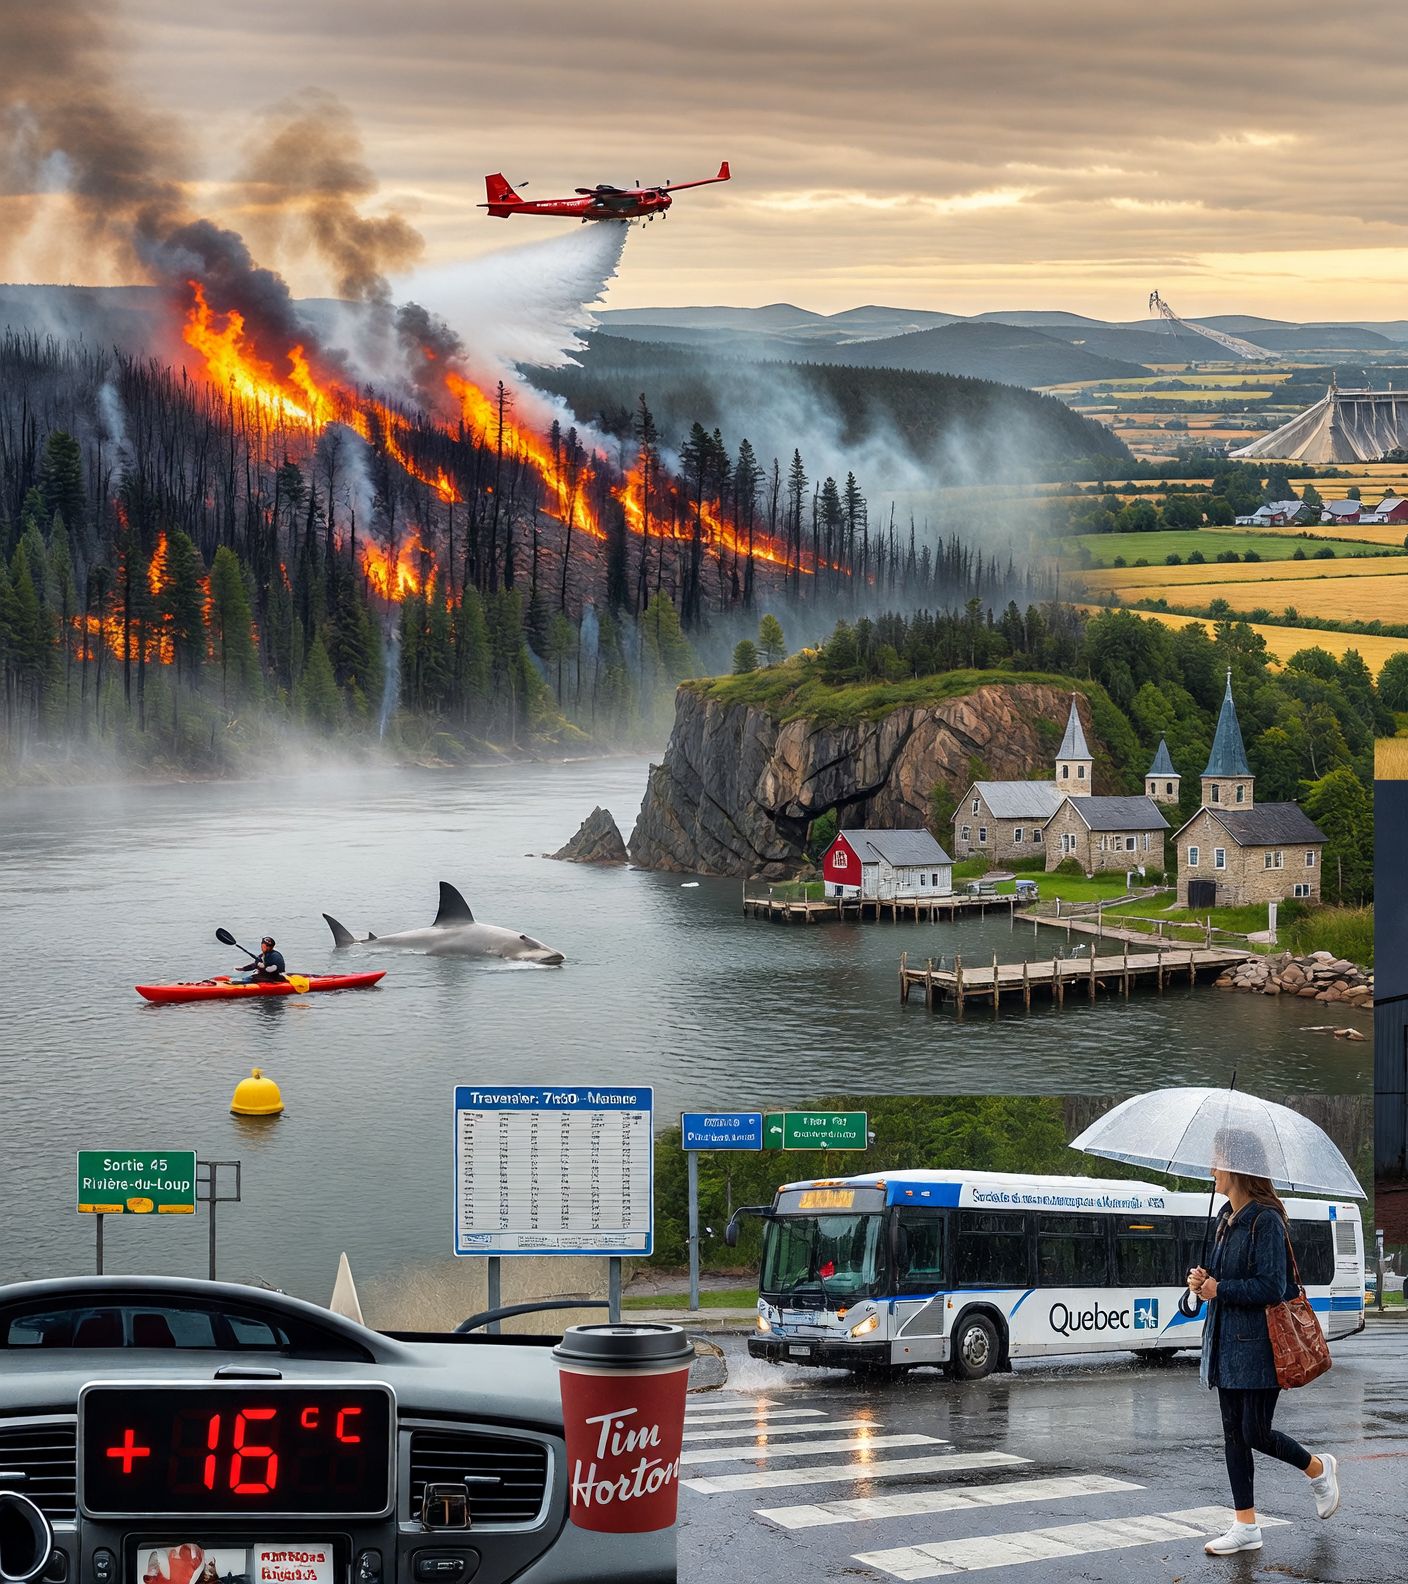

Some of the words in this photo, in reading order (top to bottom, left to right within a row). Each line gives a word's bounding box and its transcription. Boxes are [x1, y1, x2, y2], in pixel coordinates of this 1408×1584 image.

[103, 1158, 144, 1171] Sortie
[83, 1177, 190, 1193] Rivière-du-Loup
[1049, 1301, 1130, 1337] Quebec
[204, 1409, 278, 1494] 16
[585, 1407, 661, 1460] Tim
